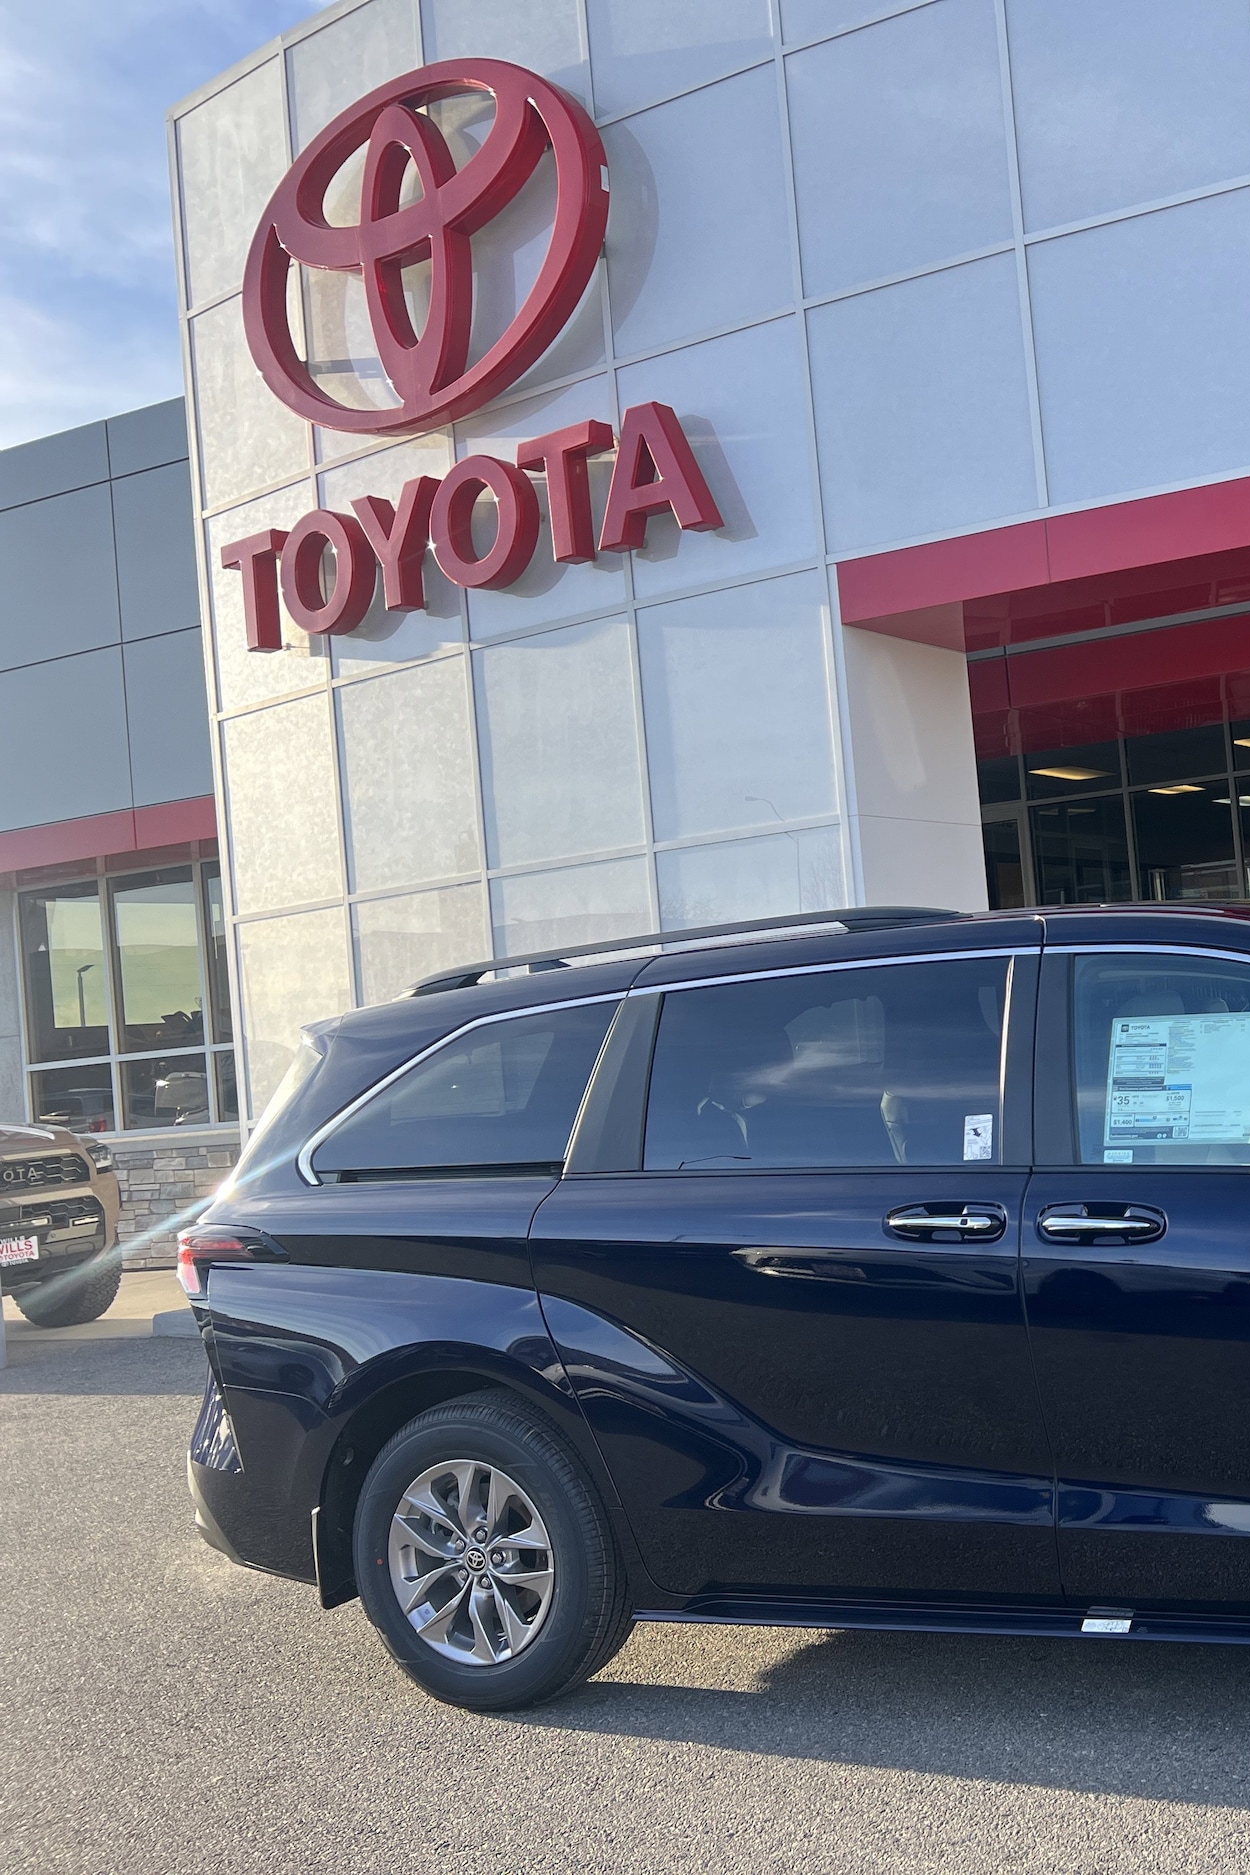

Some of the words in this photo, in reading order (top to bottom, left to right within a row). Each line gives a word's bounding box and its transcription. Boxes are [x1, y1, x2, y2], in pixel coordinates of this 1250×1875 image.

[220, 401, 725, 653] TOYOTA
[1117, 1095, 1130, 1105] 35
[4, 1250, 35, 1261] TOYOTA
